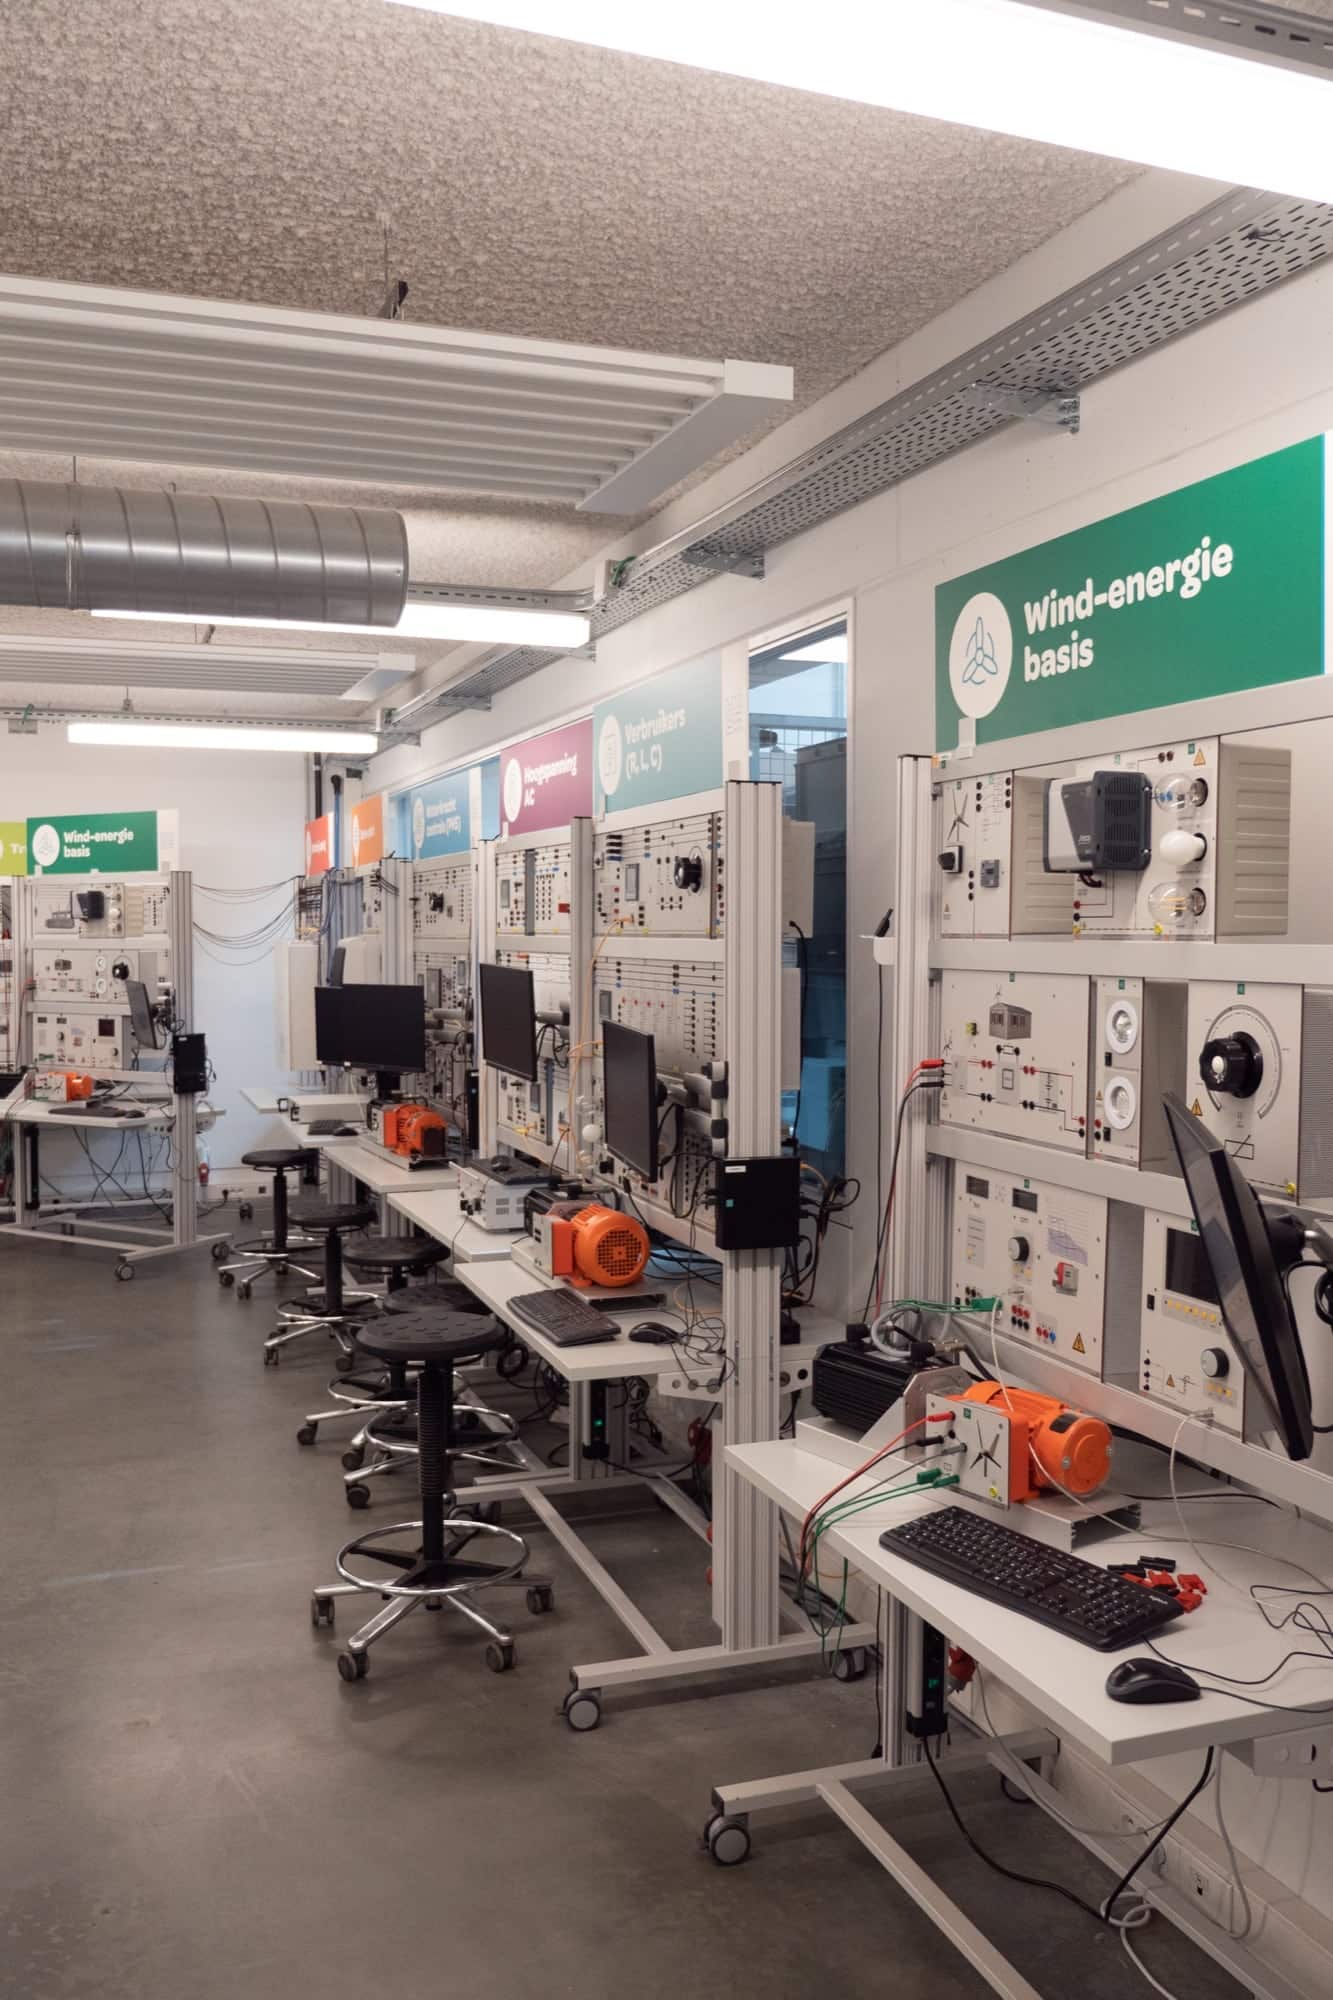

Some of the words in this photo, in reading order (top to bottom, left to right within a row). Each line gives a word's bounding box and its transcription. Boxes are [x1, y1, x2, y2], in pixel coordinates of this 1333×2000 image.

[1023, 536, 1234, 635] Wind-energie
[1024, 630, 1094, 683] basis
[624, 708, 686, 745] Verbruikers
[523, 788, 535, 807] AC
[63, 827, 134, 845] Wind-energie
[63, 844, 91, 858] basis
